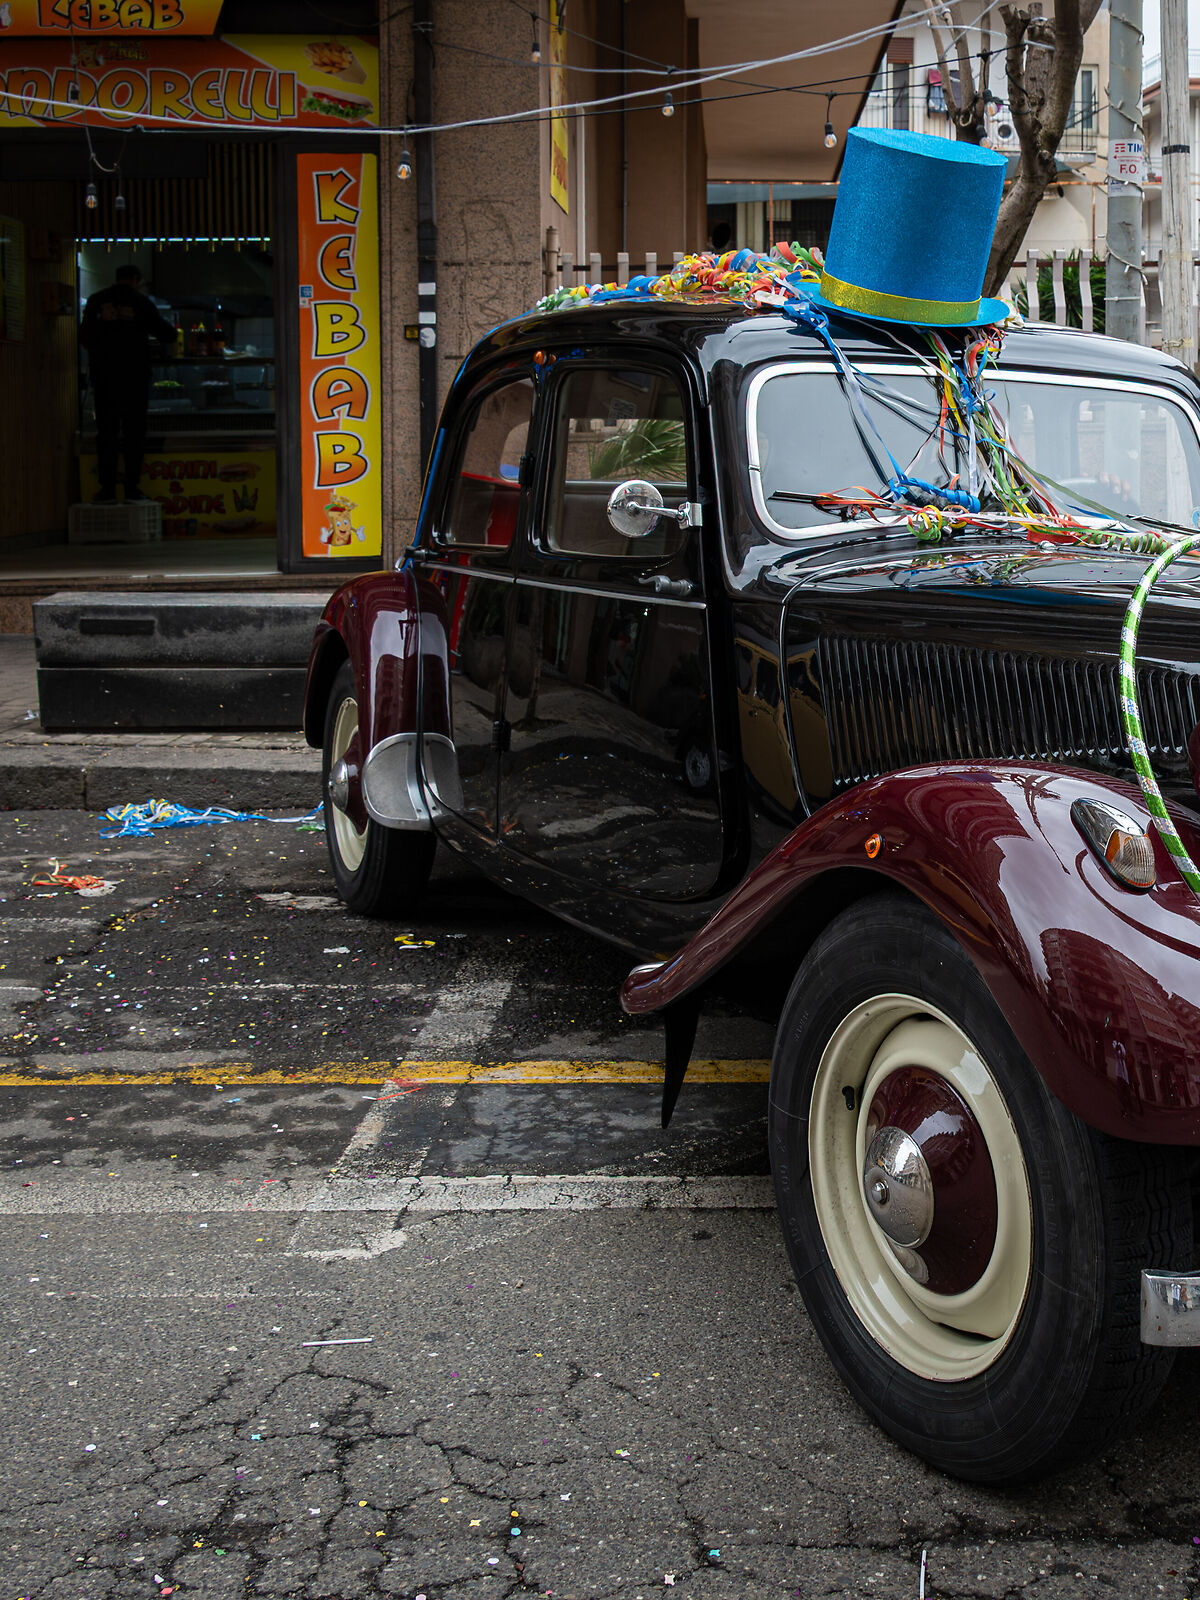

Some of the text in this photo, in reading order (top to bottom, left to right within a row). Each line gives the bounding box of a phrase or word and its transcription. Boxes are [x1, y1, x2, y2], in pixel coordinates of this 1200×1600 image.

[38, 0, 185, 30] KEBAB
[0, 67, 298, 122] NDORELLI
[311, 167, 371, 490] KEBAB
